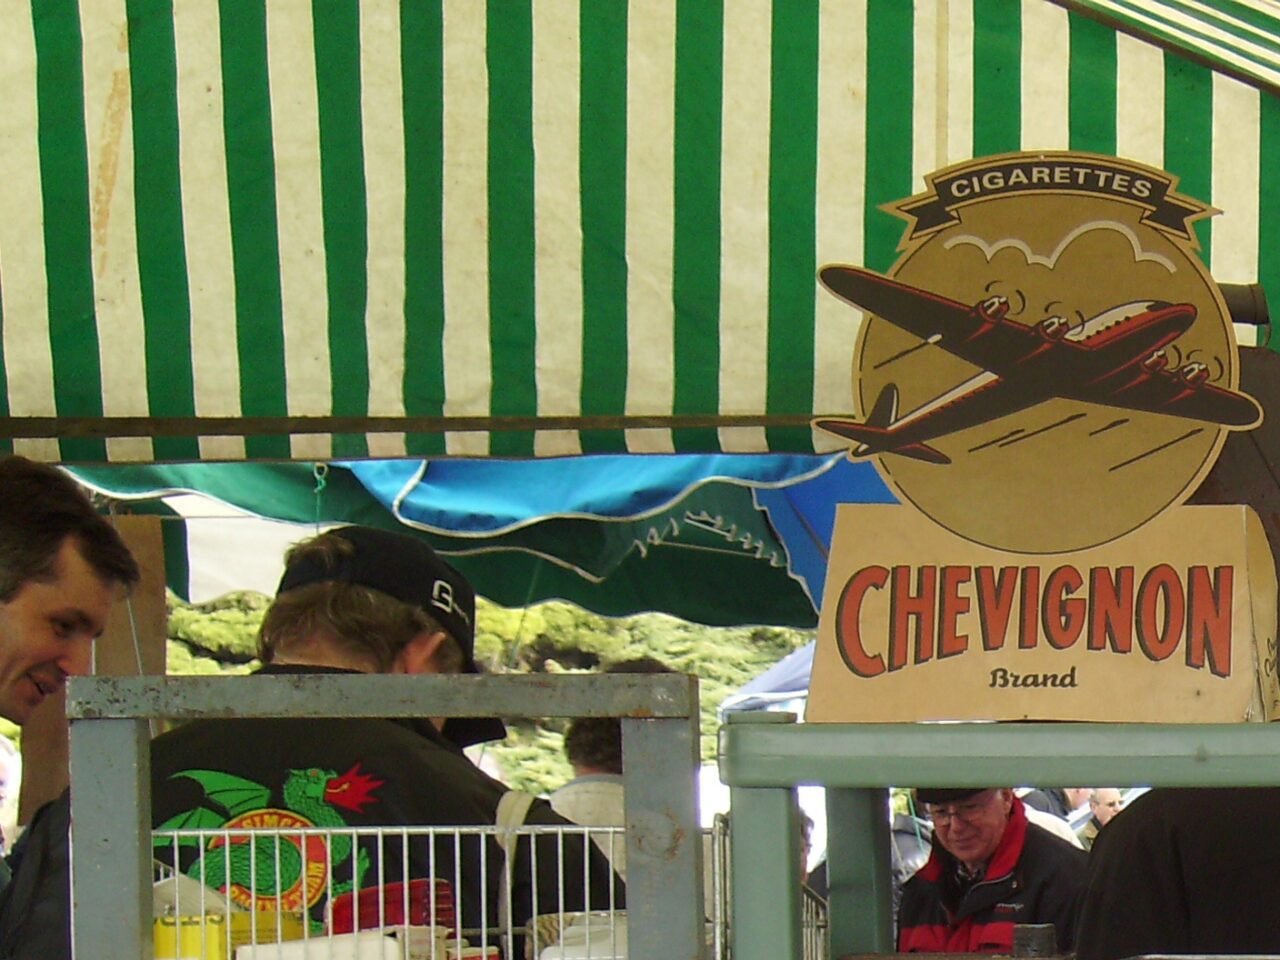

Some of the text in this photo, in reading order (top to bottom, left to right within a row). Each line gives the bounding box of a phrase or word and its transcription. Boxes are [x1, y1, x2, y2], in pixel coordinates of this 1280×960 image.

[951, 165, 1152, 198] CIGARETTES
[836, 564, 1233, 678] CHEVIGNON
[989, 666, 1078, 689] Brand
